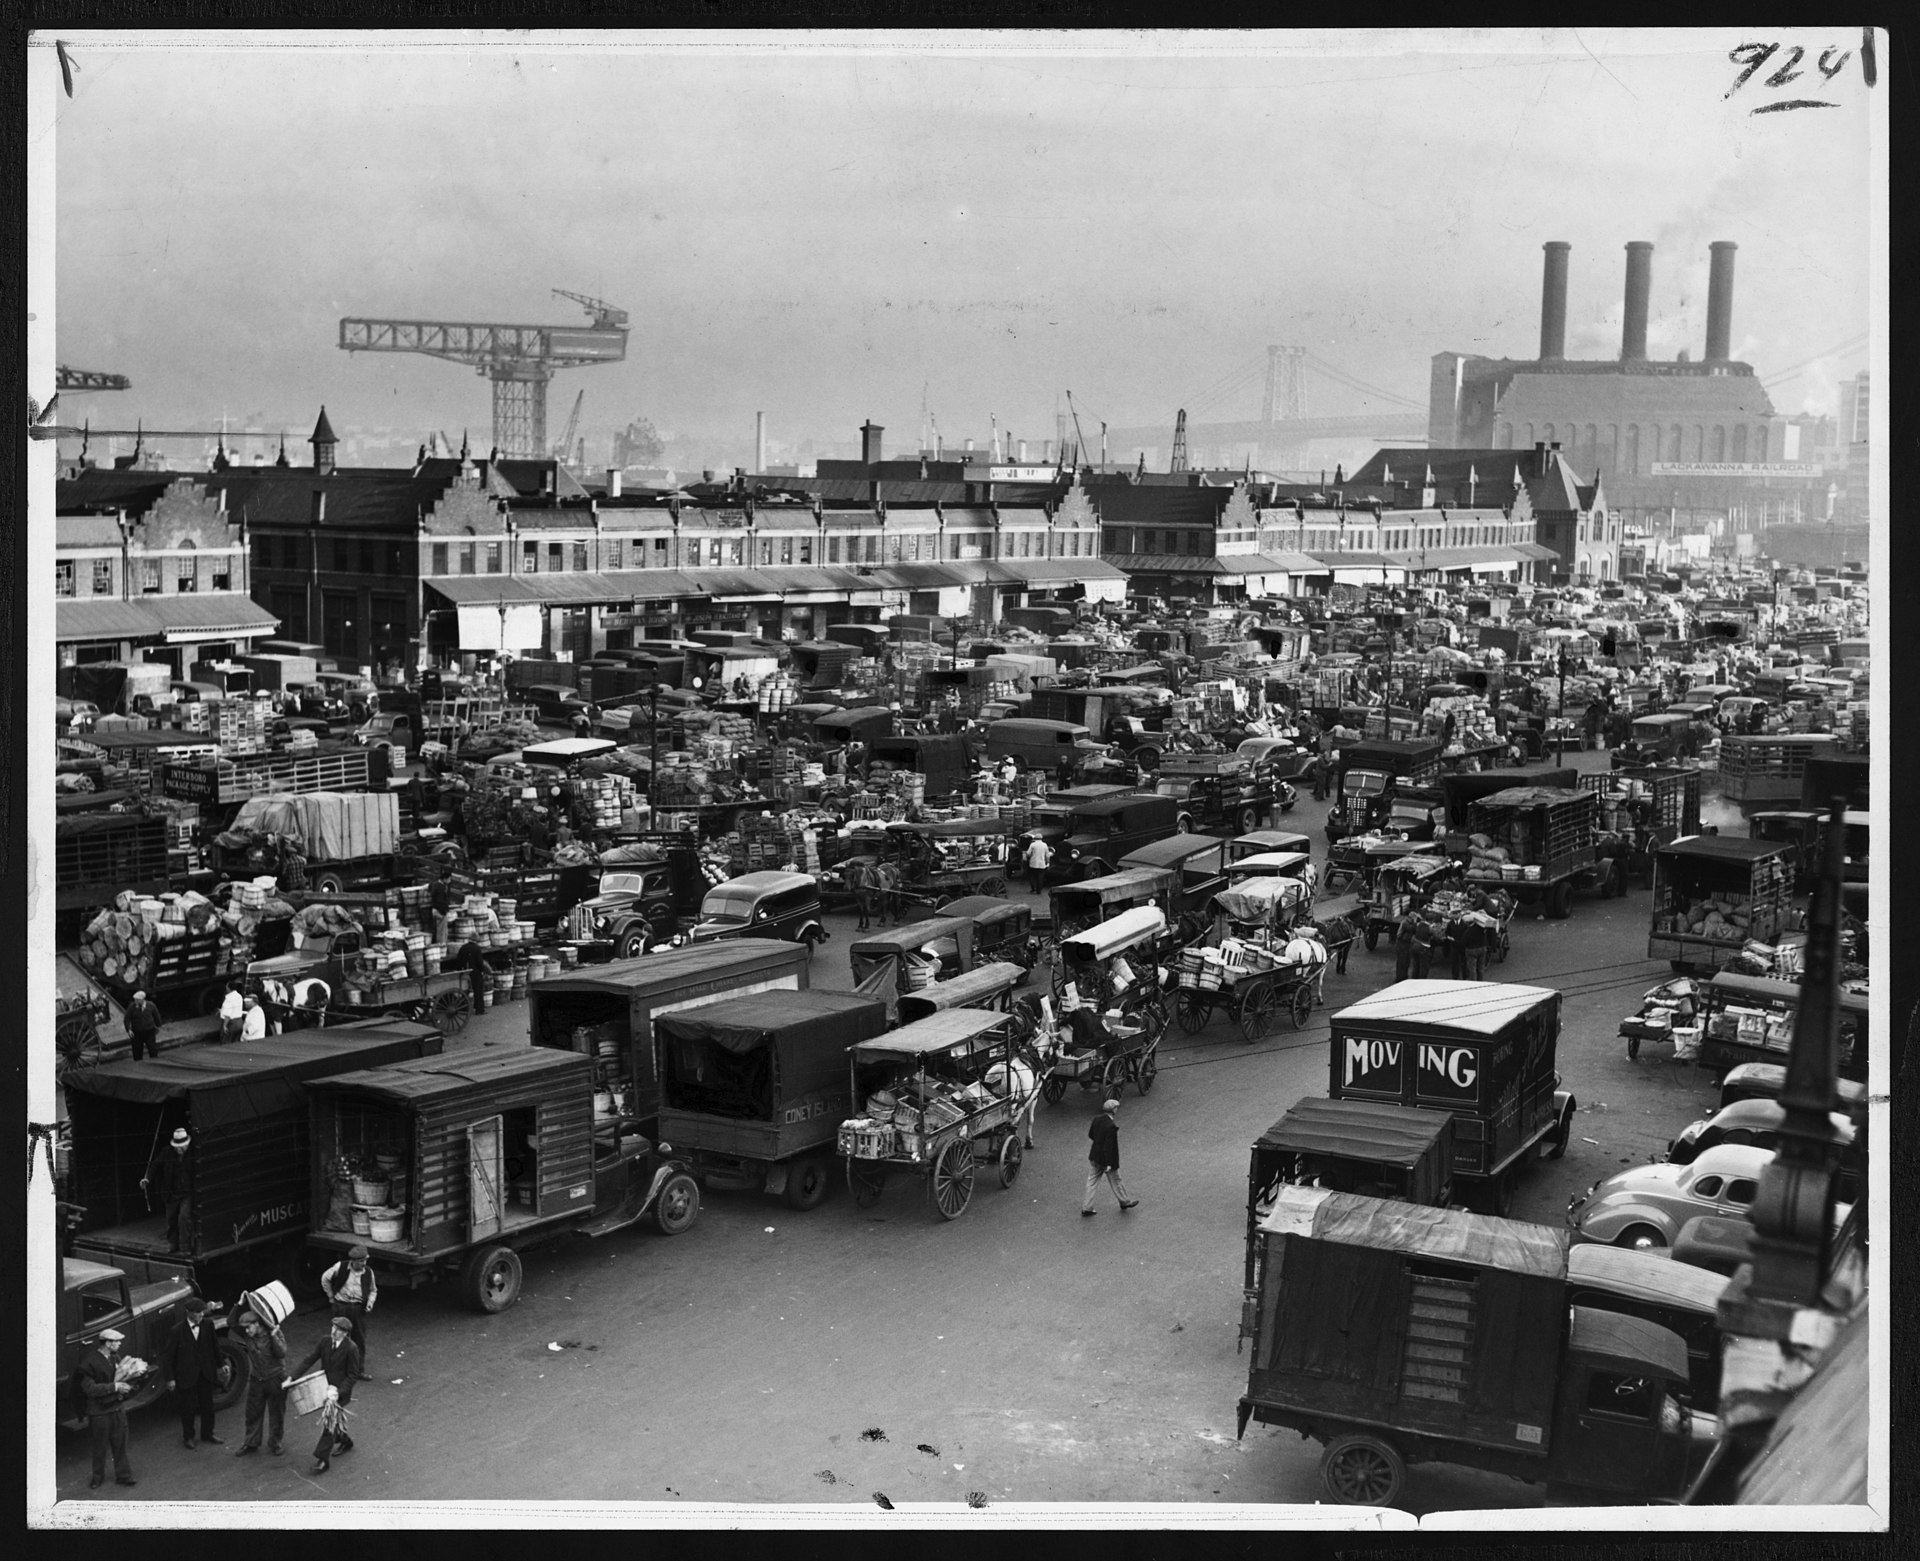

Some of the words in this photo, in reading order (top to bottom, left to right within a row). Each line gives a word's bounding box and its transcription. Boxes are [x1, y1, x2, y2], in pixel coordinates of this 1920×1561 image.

[1661, 463, 1745, 471] LACKAWANNA
[1751, 463, 1814, 472] RAILROAD
[171, 769, 207, 783] INTERBORO
[166, 778, 190, 790] PACKAGE
[190, 784, 211, 794] SUPPLY
[785, 1104, 812, 1124] CONEY
